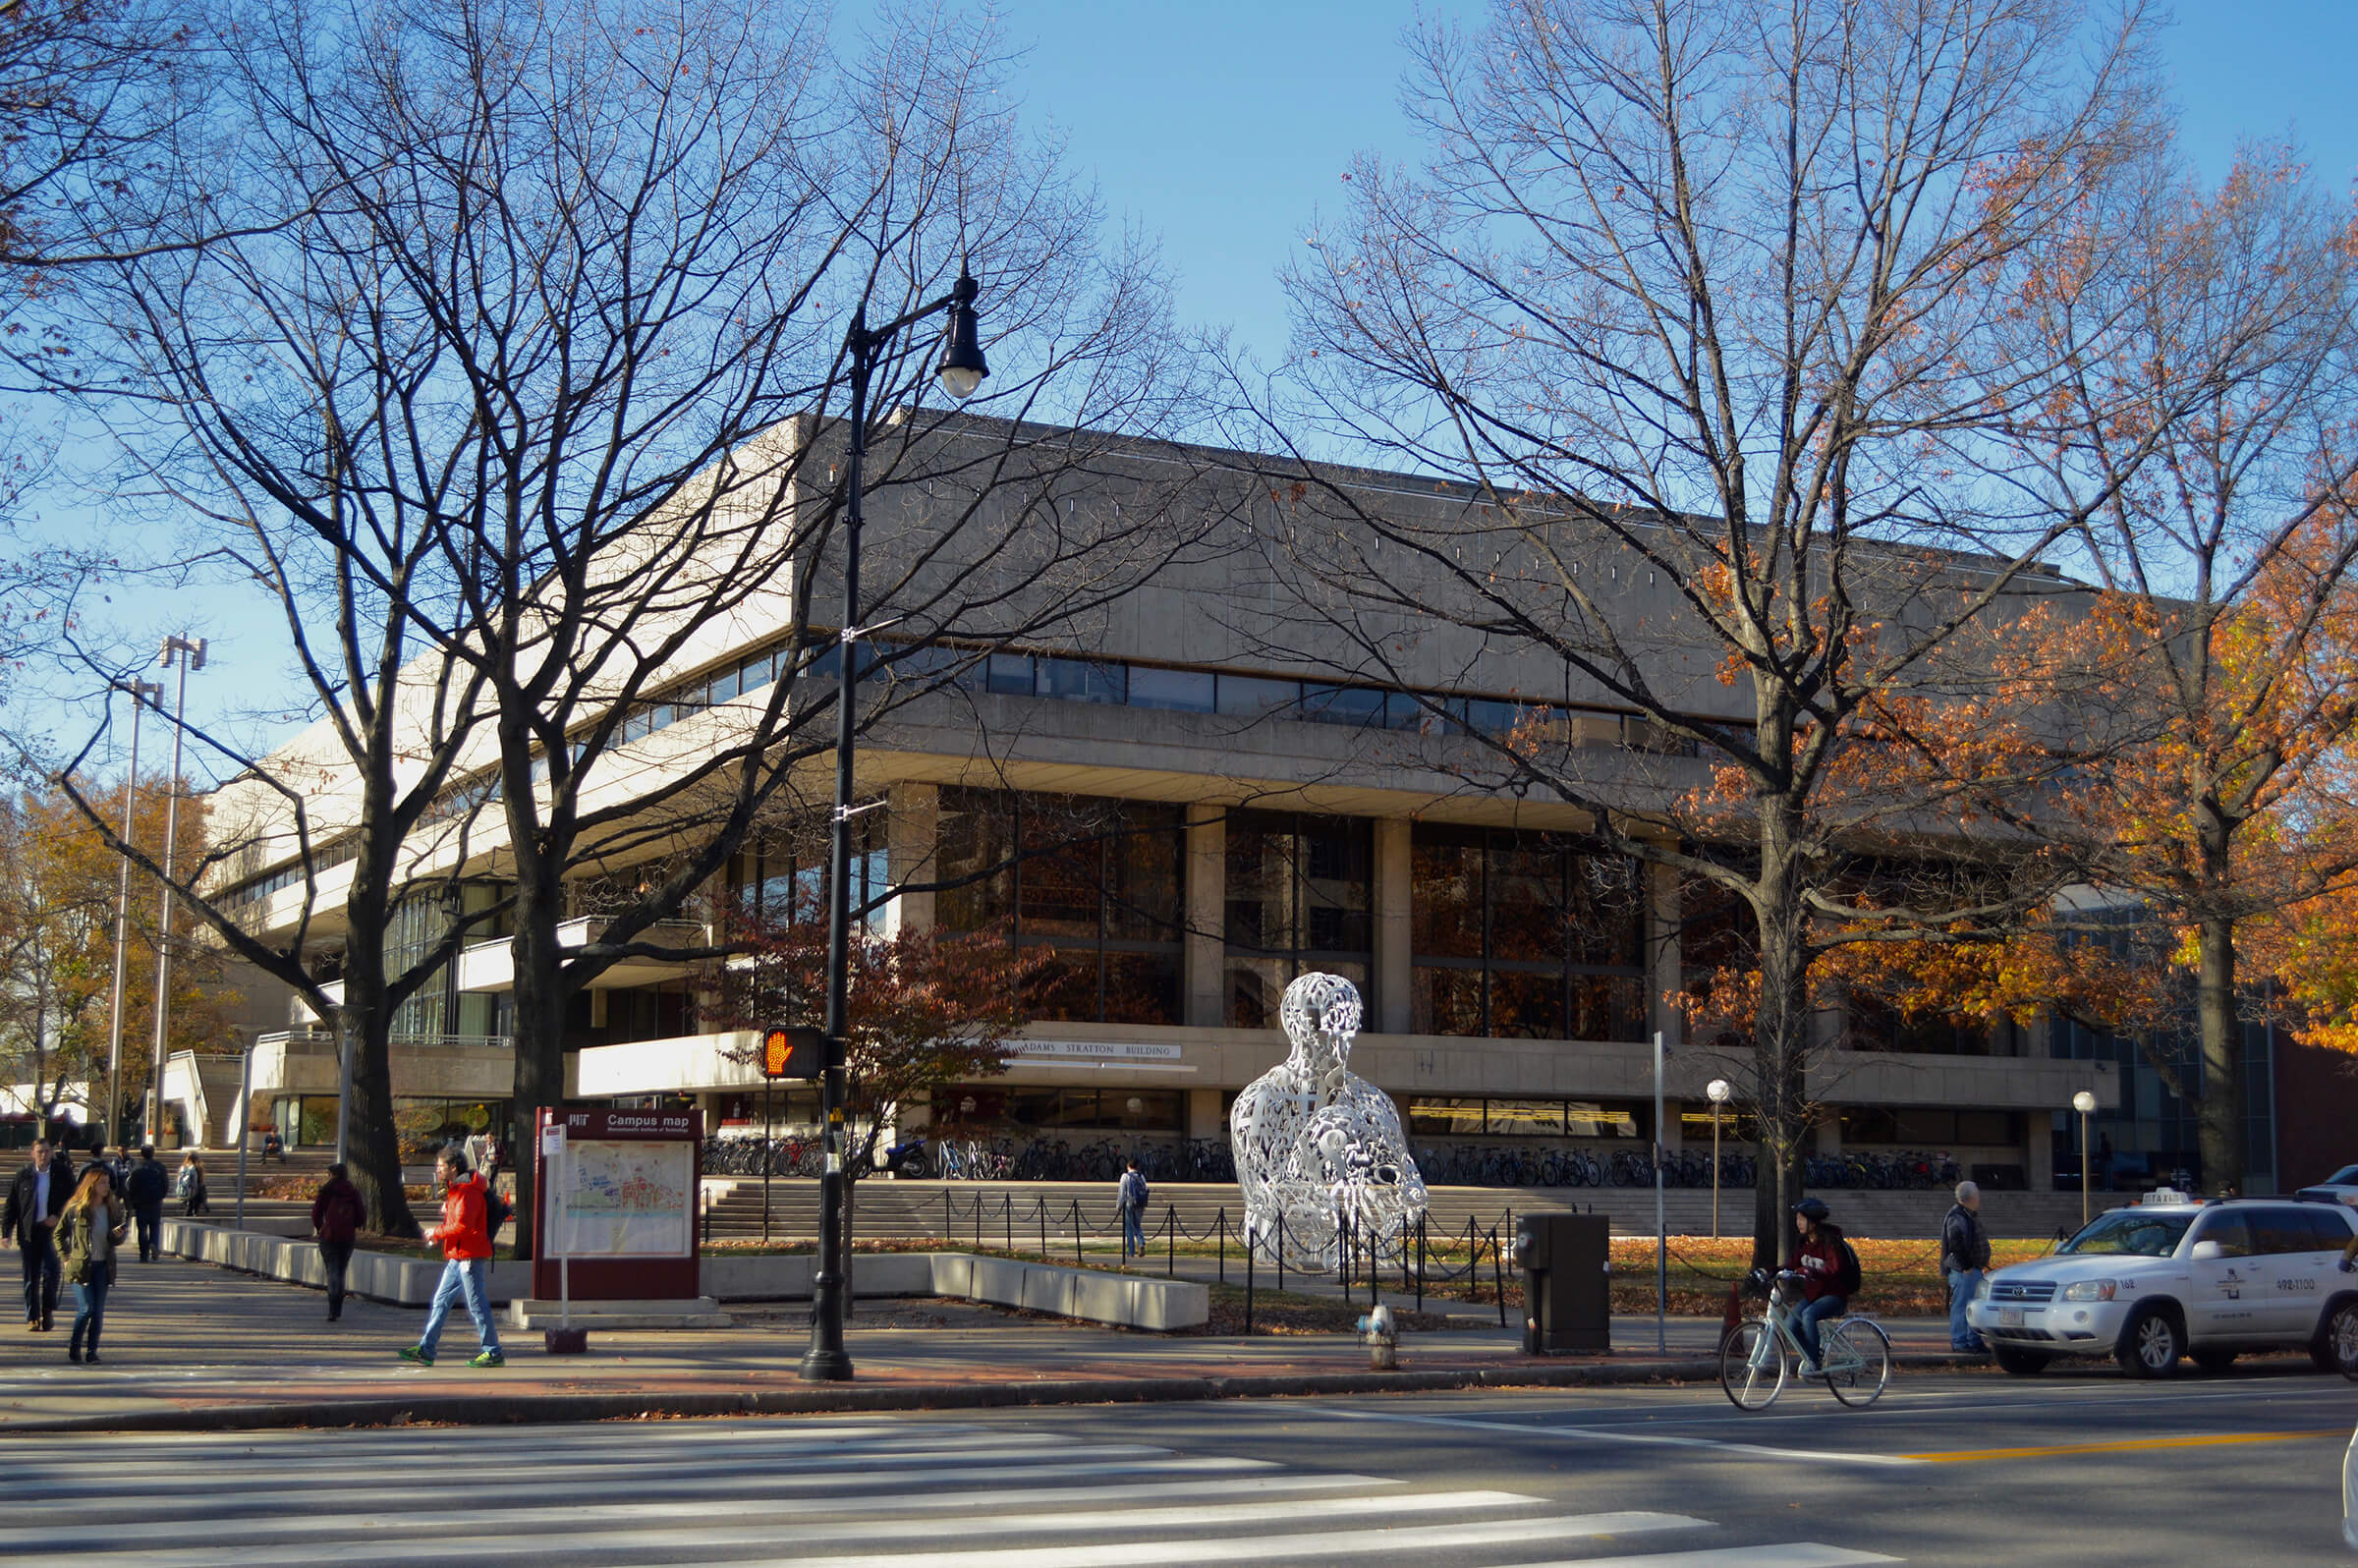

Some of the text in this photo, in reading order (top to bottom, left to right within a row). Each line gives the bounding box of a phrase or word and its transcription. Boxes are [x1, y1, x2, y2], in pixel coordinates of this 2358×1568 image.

[1023, 1042, 1056, 1052] ADAMS
[1066, 1043, 1114, 1054] STRATTON
[1126, 1044, 1170, 1055] BUILDING
[569, 1114, 590, 1126] MIT
[607, 1114, 690, 1128] Campus map
[2152, 1194, 2171, 1203] TAXI
[2120, 1280, 2135, 1290] 162
